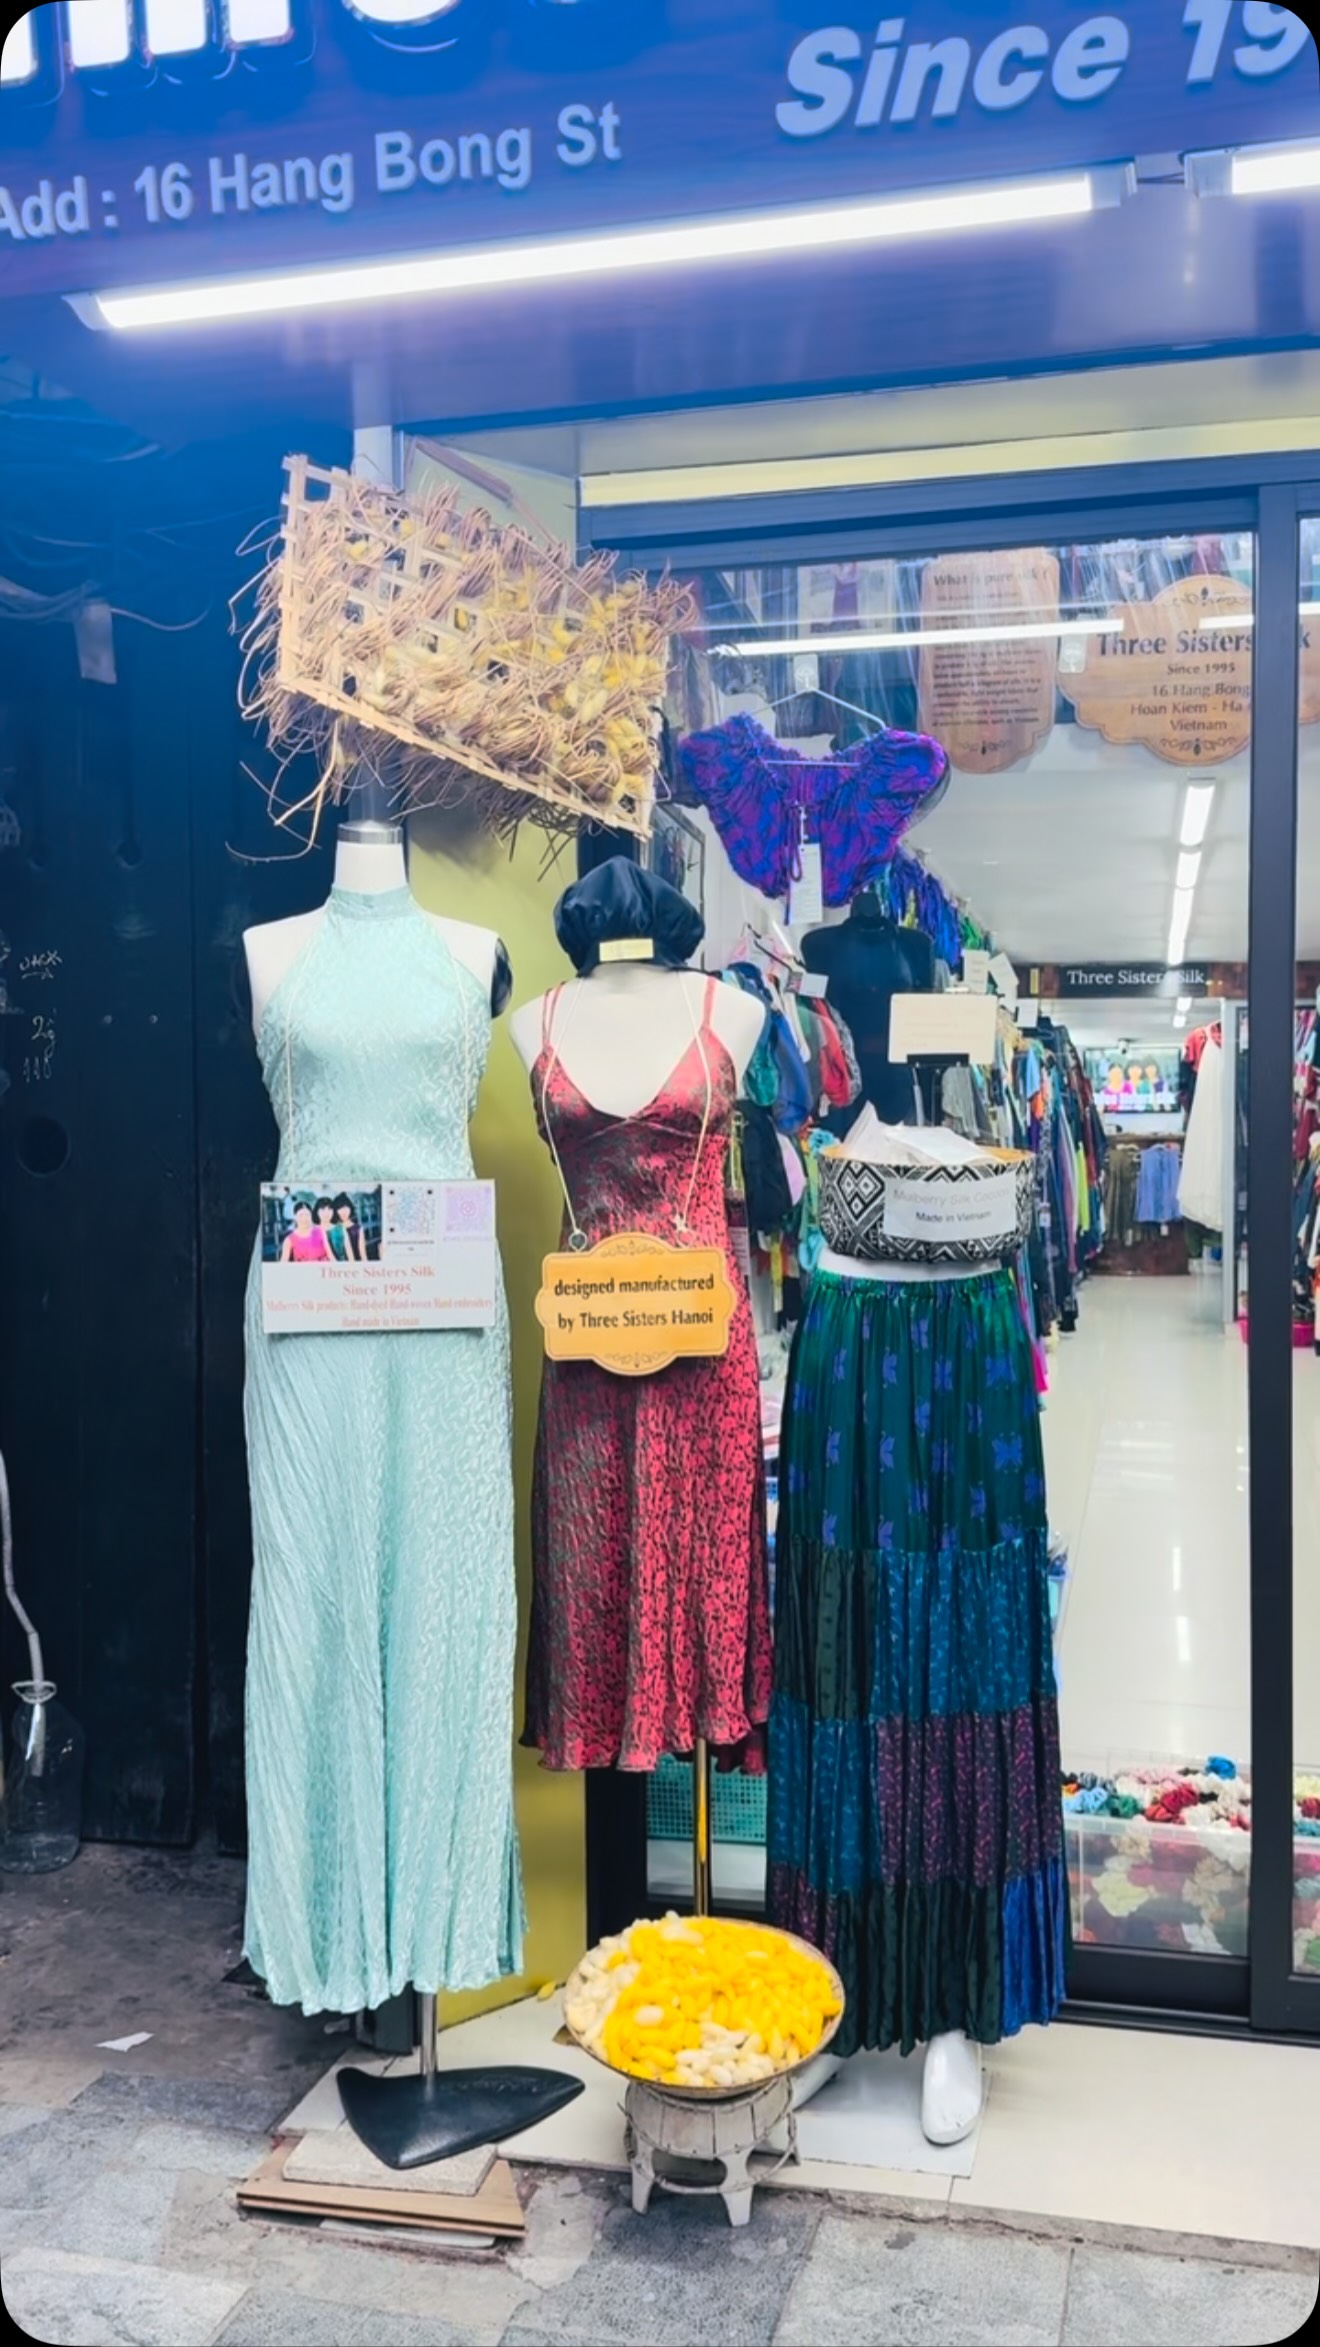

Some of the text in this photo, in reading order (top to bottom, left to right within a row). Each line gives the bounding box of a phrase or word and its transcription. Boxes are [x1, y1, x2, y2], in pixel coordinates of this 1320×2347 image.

[775, 15, 1131, 137] Since
[134, 162, 193, 223] 16
[209, 152, 354, 213] Hang
[374, 128, 533, 191] Bong
[556, 101, 622, 167] St
[1097, 632, 1168, 656] Three
[1167, 661, 1235, 676] Since 1995
[1152, 684, 1169, 697] 16
[1173, 684, 1211, 699] Hang
[1130, 702, 1167, 716] Hoan
[1172, 701, 1208, 716] Kiem
[1169, 718, 1228, 732] Vietnam
[1066, 969, 1114, 985] Three
[1117, 968, 1167, 985] Sister
[915, 1211, 992, 1223] Made in Vietnam
[320, 1264, 435, 1279] Three Sisters Silk
[342, 1282, 412, 1296] Since 1995
[554, 1273, 714, 1299] designed manufactured
[557, 1307, 714, 1334] by Three Sisters Hanoi
